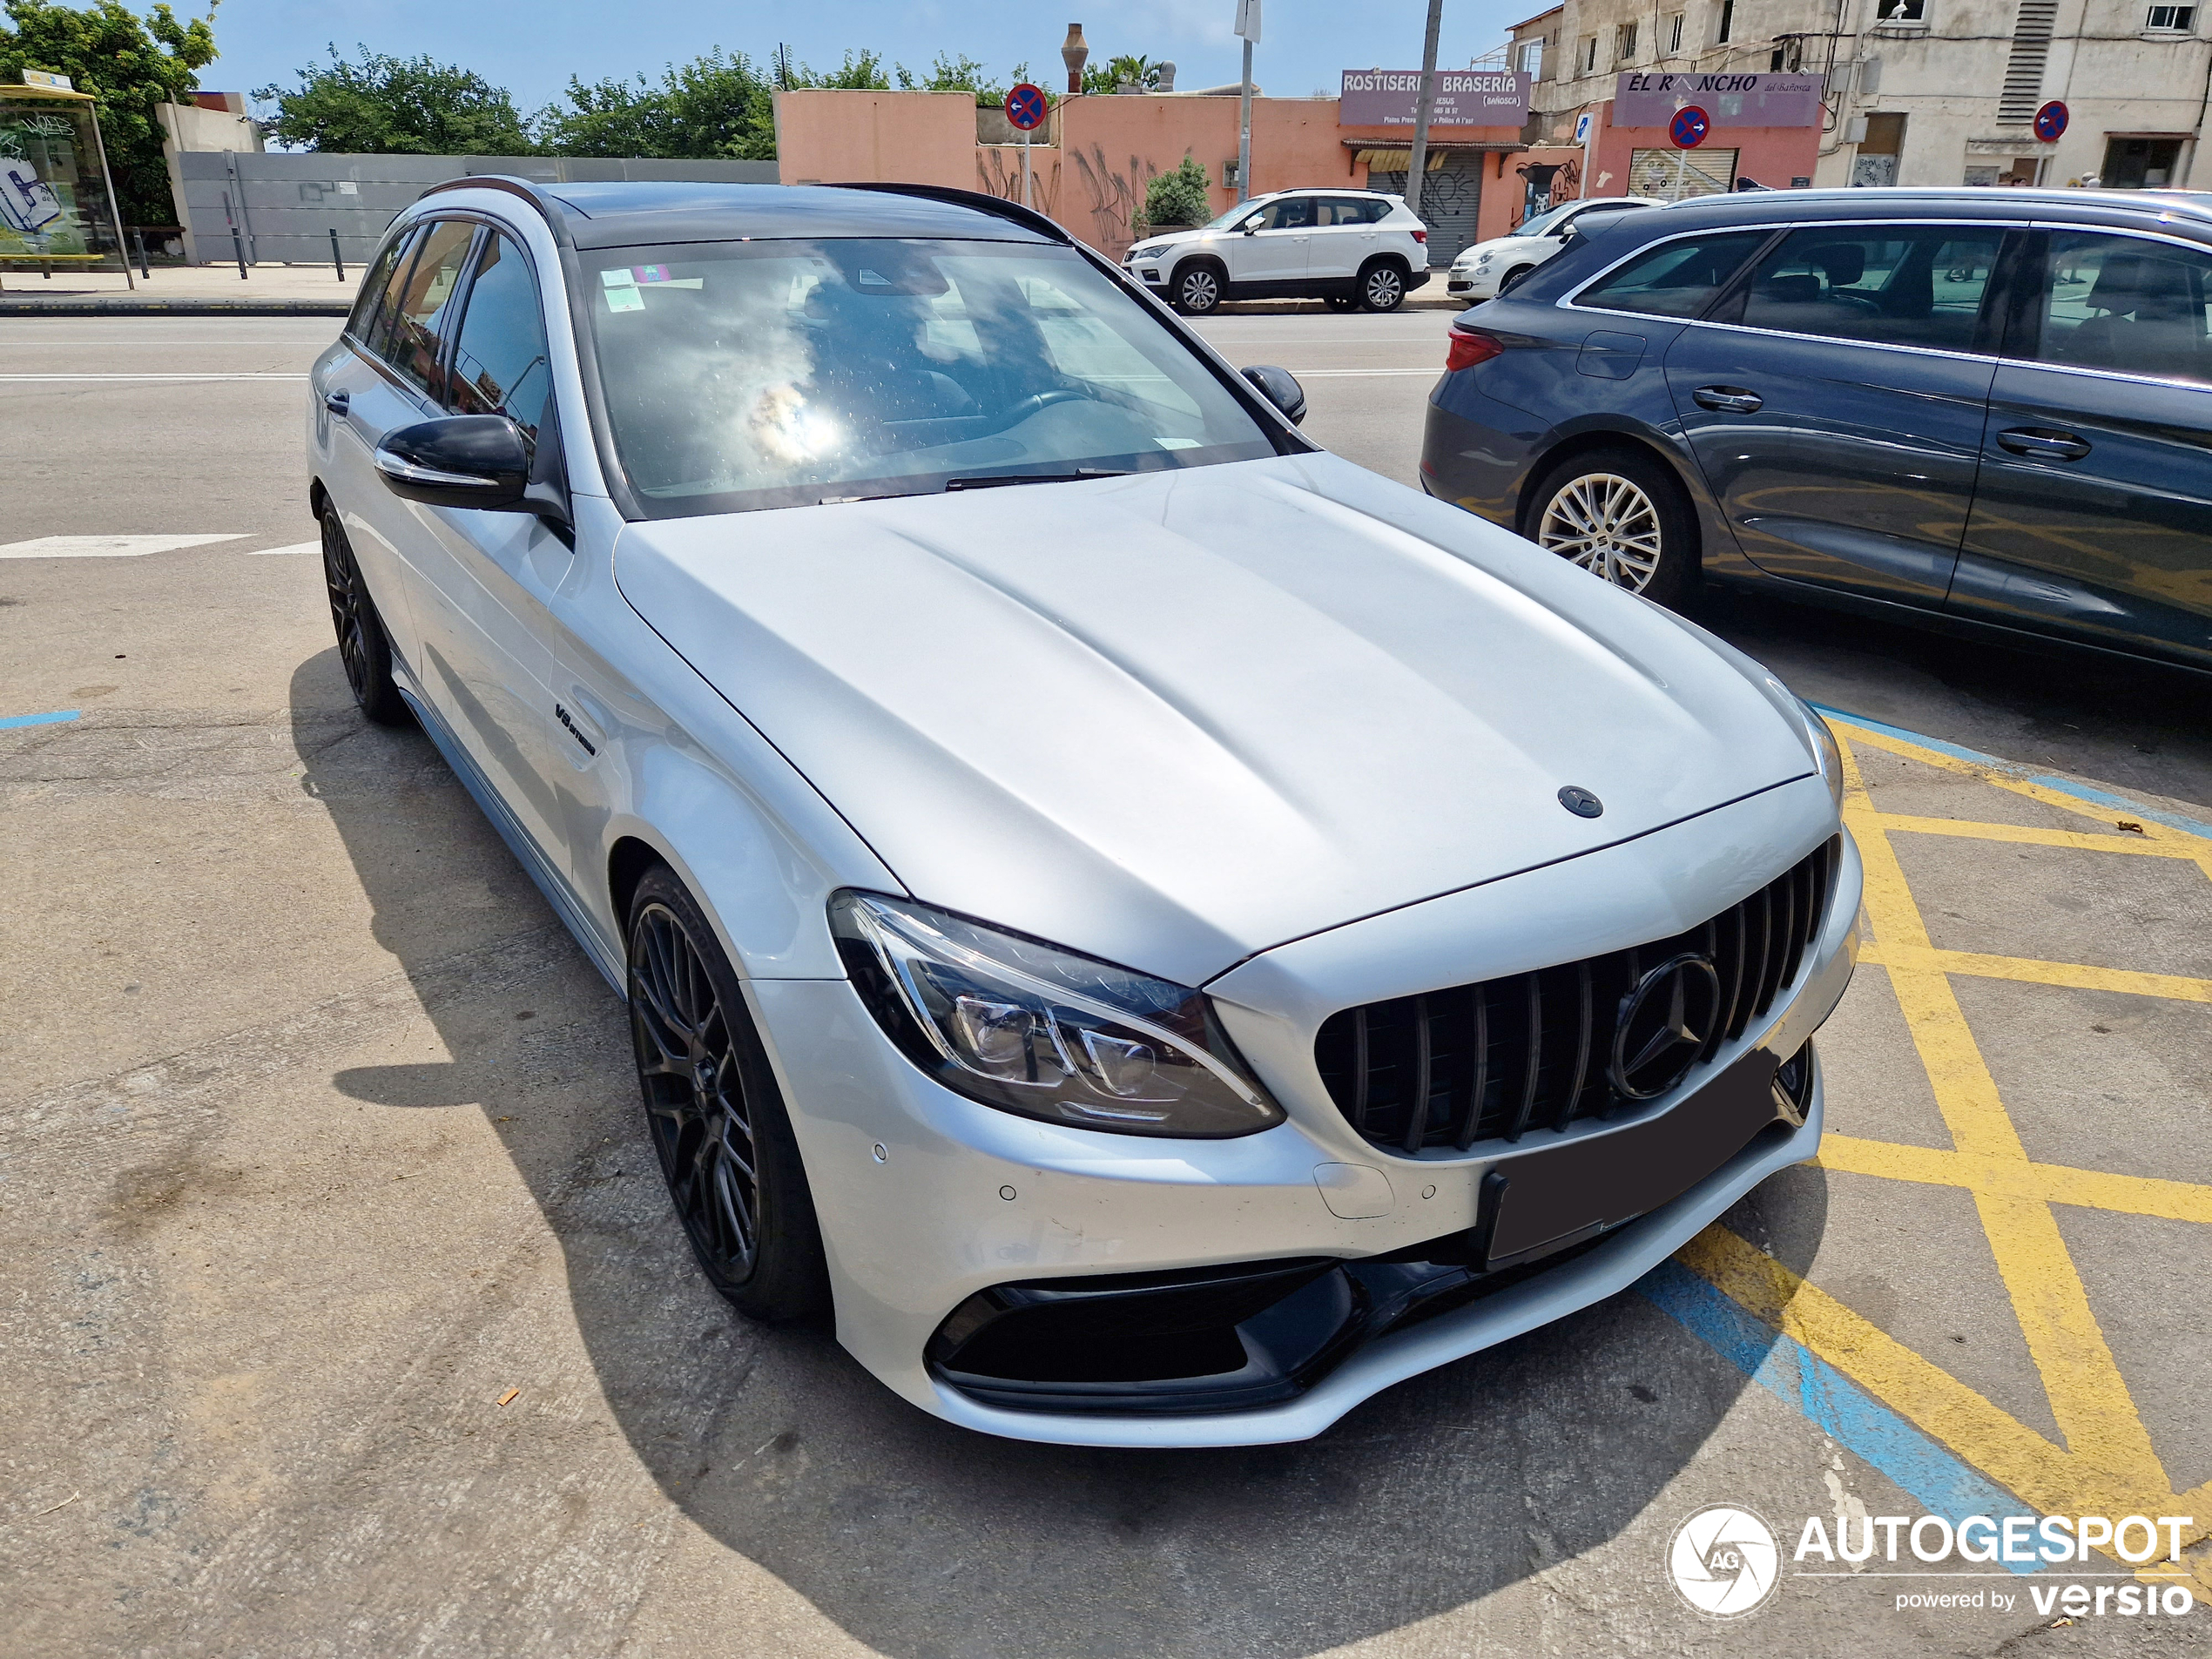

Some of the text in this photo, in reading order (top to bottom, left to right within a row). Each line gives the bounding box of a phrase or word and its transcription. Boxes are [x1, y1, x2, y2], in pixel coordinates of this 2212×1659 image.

[1442, 76, 1516, 92] BRASERIA
[1628, 75, 1650, 91] EL
[1764, 83, 1777, 91] del
[1777, 83, 1811, 91] Bañosca
[1435, 95, 1521, 107] JESUS (BAÑOSCA)
[556, 704, 596, 756] V8 BITURBO
